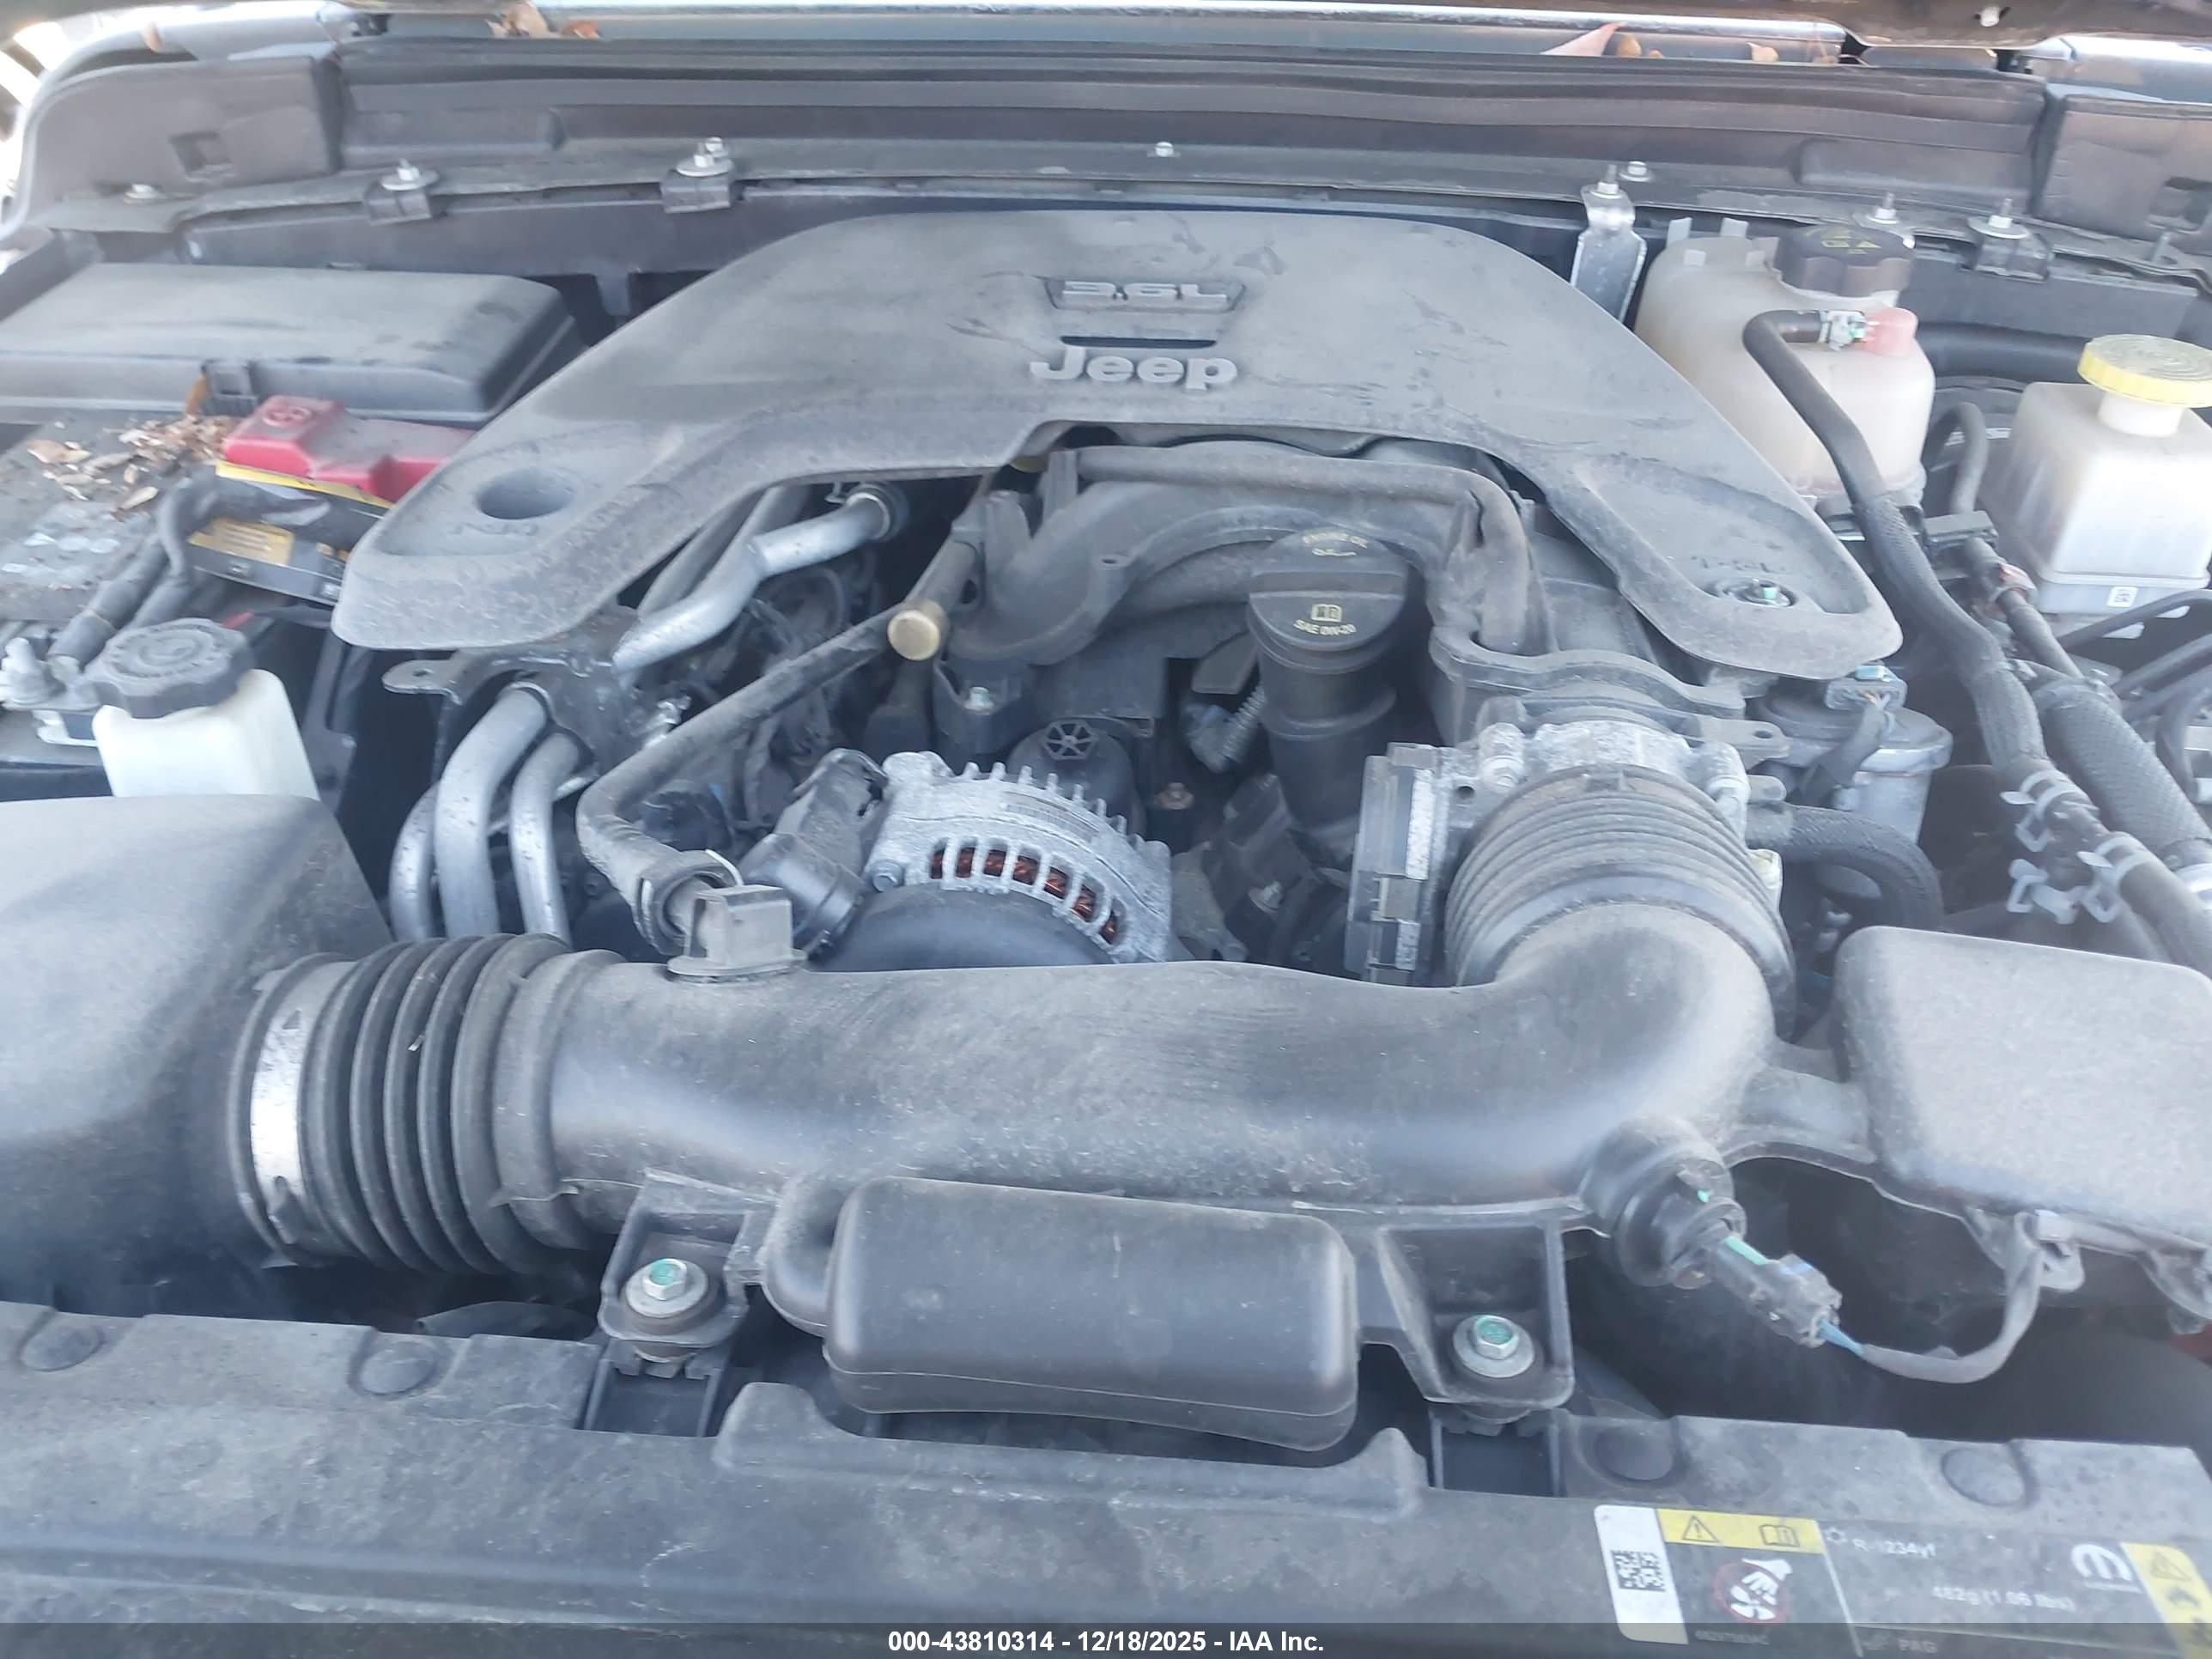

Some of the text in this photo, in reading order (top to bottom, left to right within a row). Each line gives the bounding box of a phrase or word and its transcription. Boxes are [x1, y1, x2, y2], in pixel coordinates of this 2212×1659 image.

[1062, 280, 1228, 300] 3.6L
[1030, 345, 1237, 391] Jeep
[1293, 619, 1320, 635] SAE
[1899, 1638, 1938, 1654] PAG
